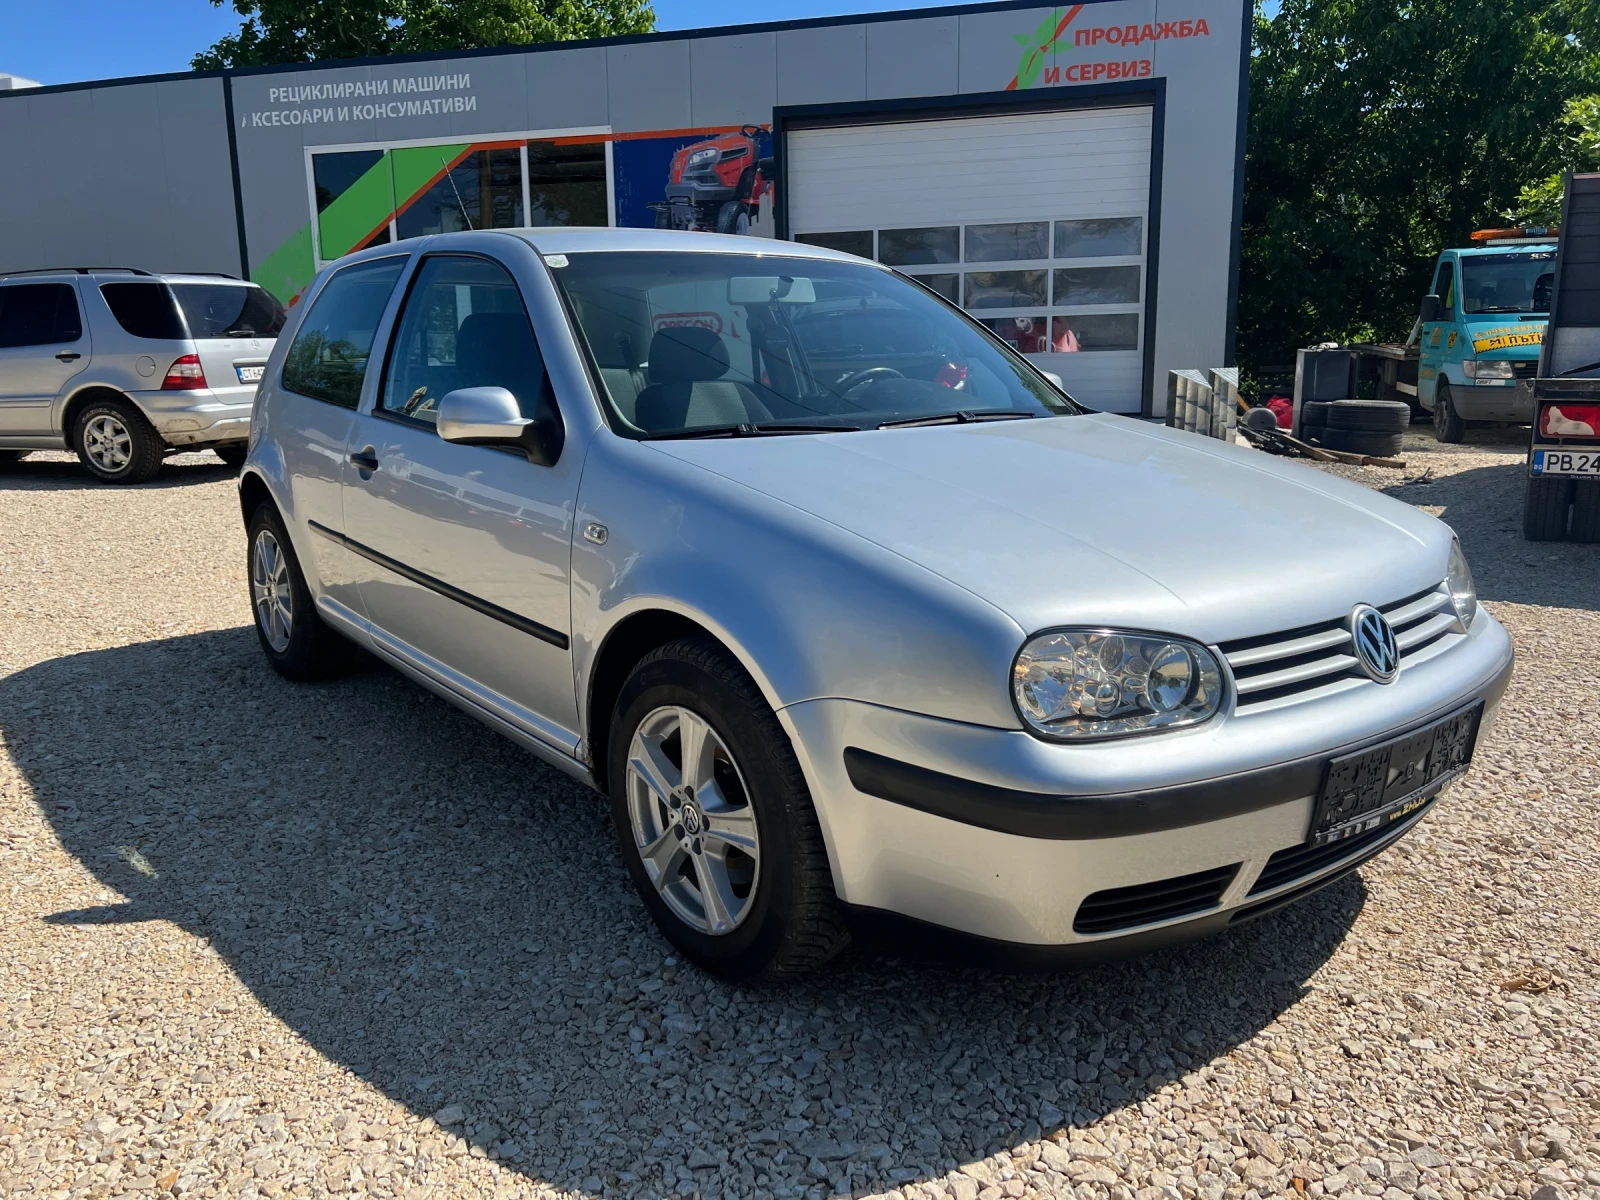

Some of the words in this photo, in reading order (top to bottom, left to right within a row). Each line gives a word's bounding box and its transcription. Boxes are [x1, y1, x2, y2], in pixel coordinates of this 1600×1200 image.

[1075, 18, 1209, 47] ПРОДАЖБА
[1044, 66, 1060, 84] И
[1065, 59, 1152, 82] СЕРВИЗ
[269, 79, 389, 104] РЕЦИКЛИРАНИ
[393, 73, 471, 95] МАШИНИ
[337, 106, 350, 122] И
[353, 96, 477, 121] КОНСУМАТИВИ
